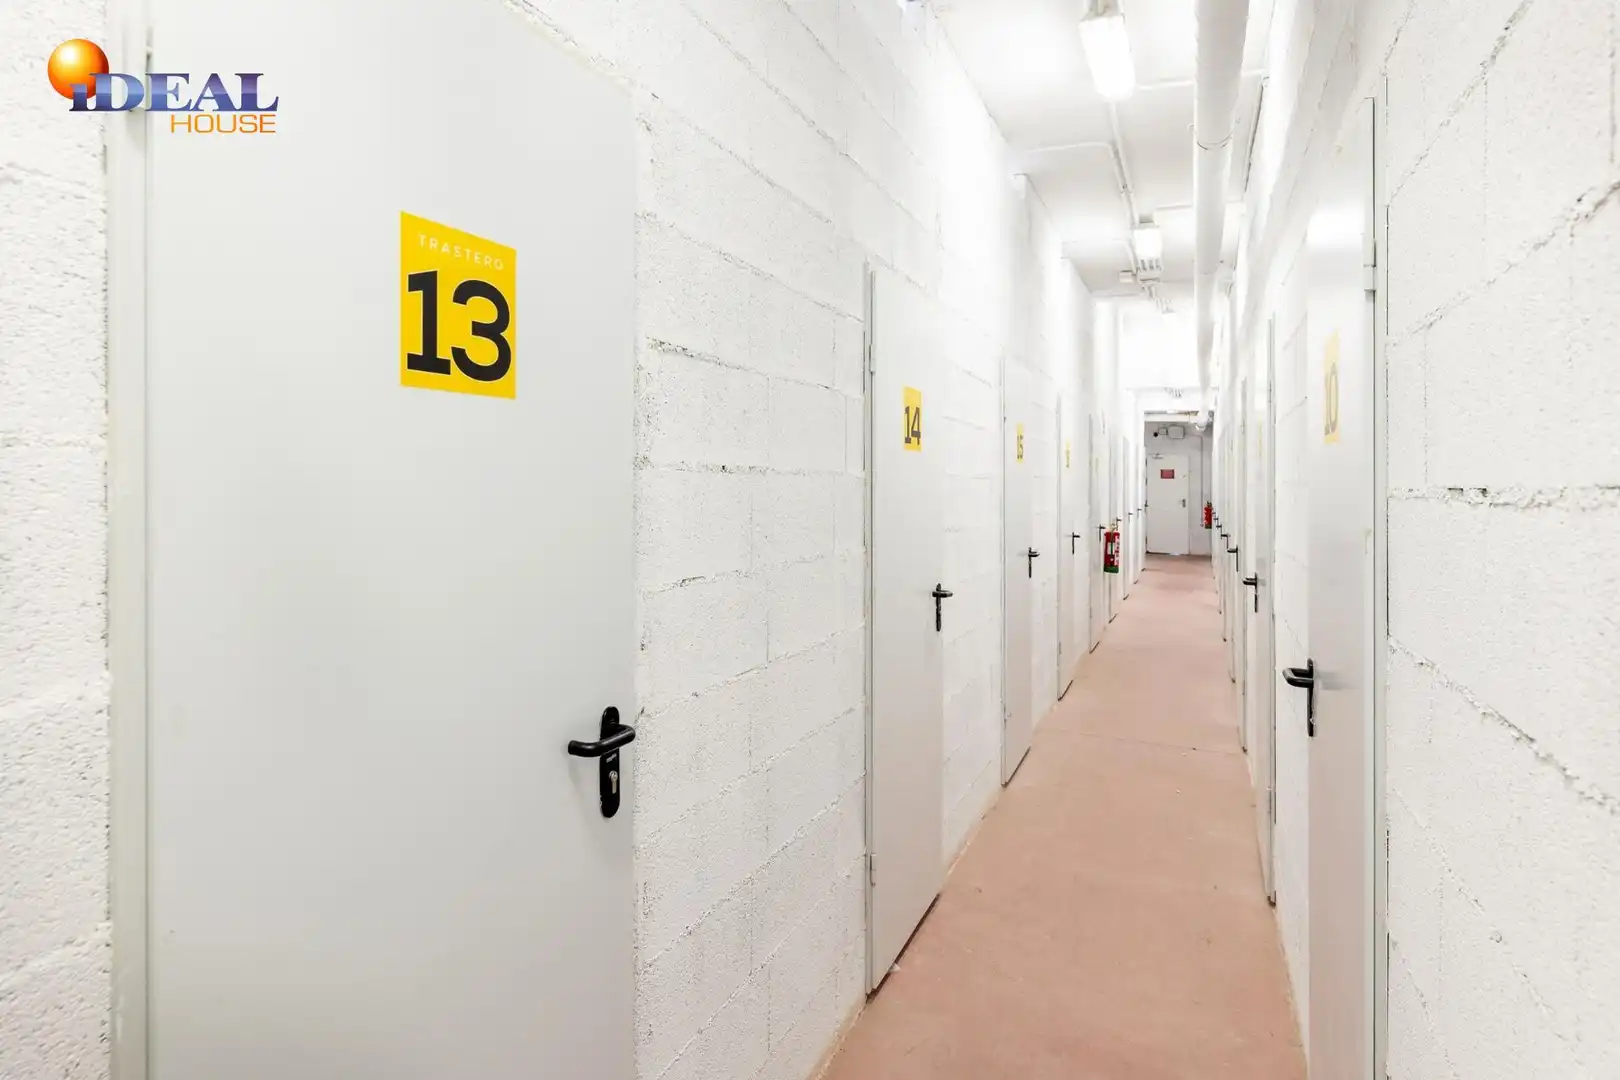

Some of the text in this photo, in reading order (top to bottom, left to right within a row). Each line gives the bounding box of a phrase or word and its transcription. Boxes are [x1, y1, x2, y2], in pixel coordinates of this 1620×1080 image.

[418, 234, 504, 270] TRASTERO
[407, 270, 512, 382] 13
[1324, 363, 1339, 436] 10
[904, 406, 921, 446] 14
[1016, 435, 1024, 459] 15
